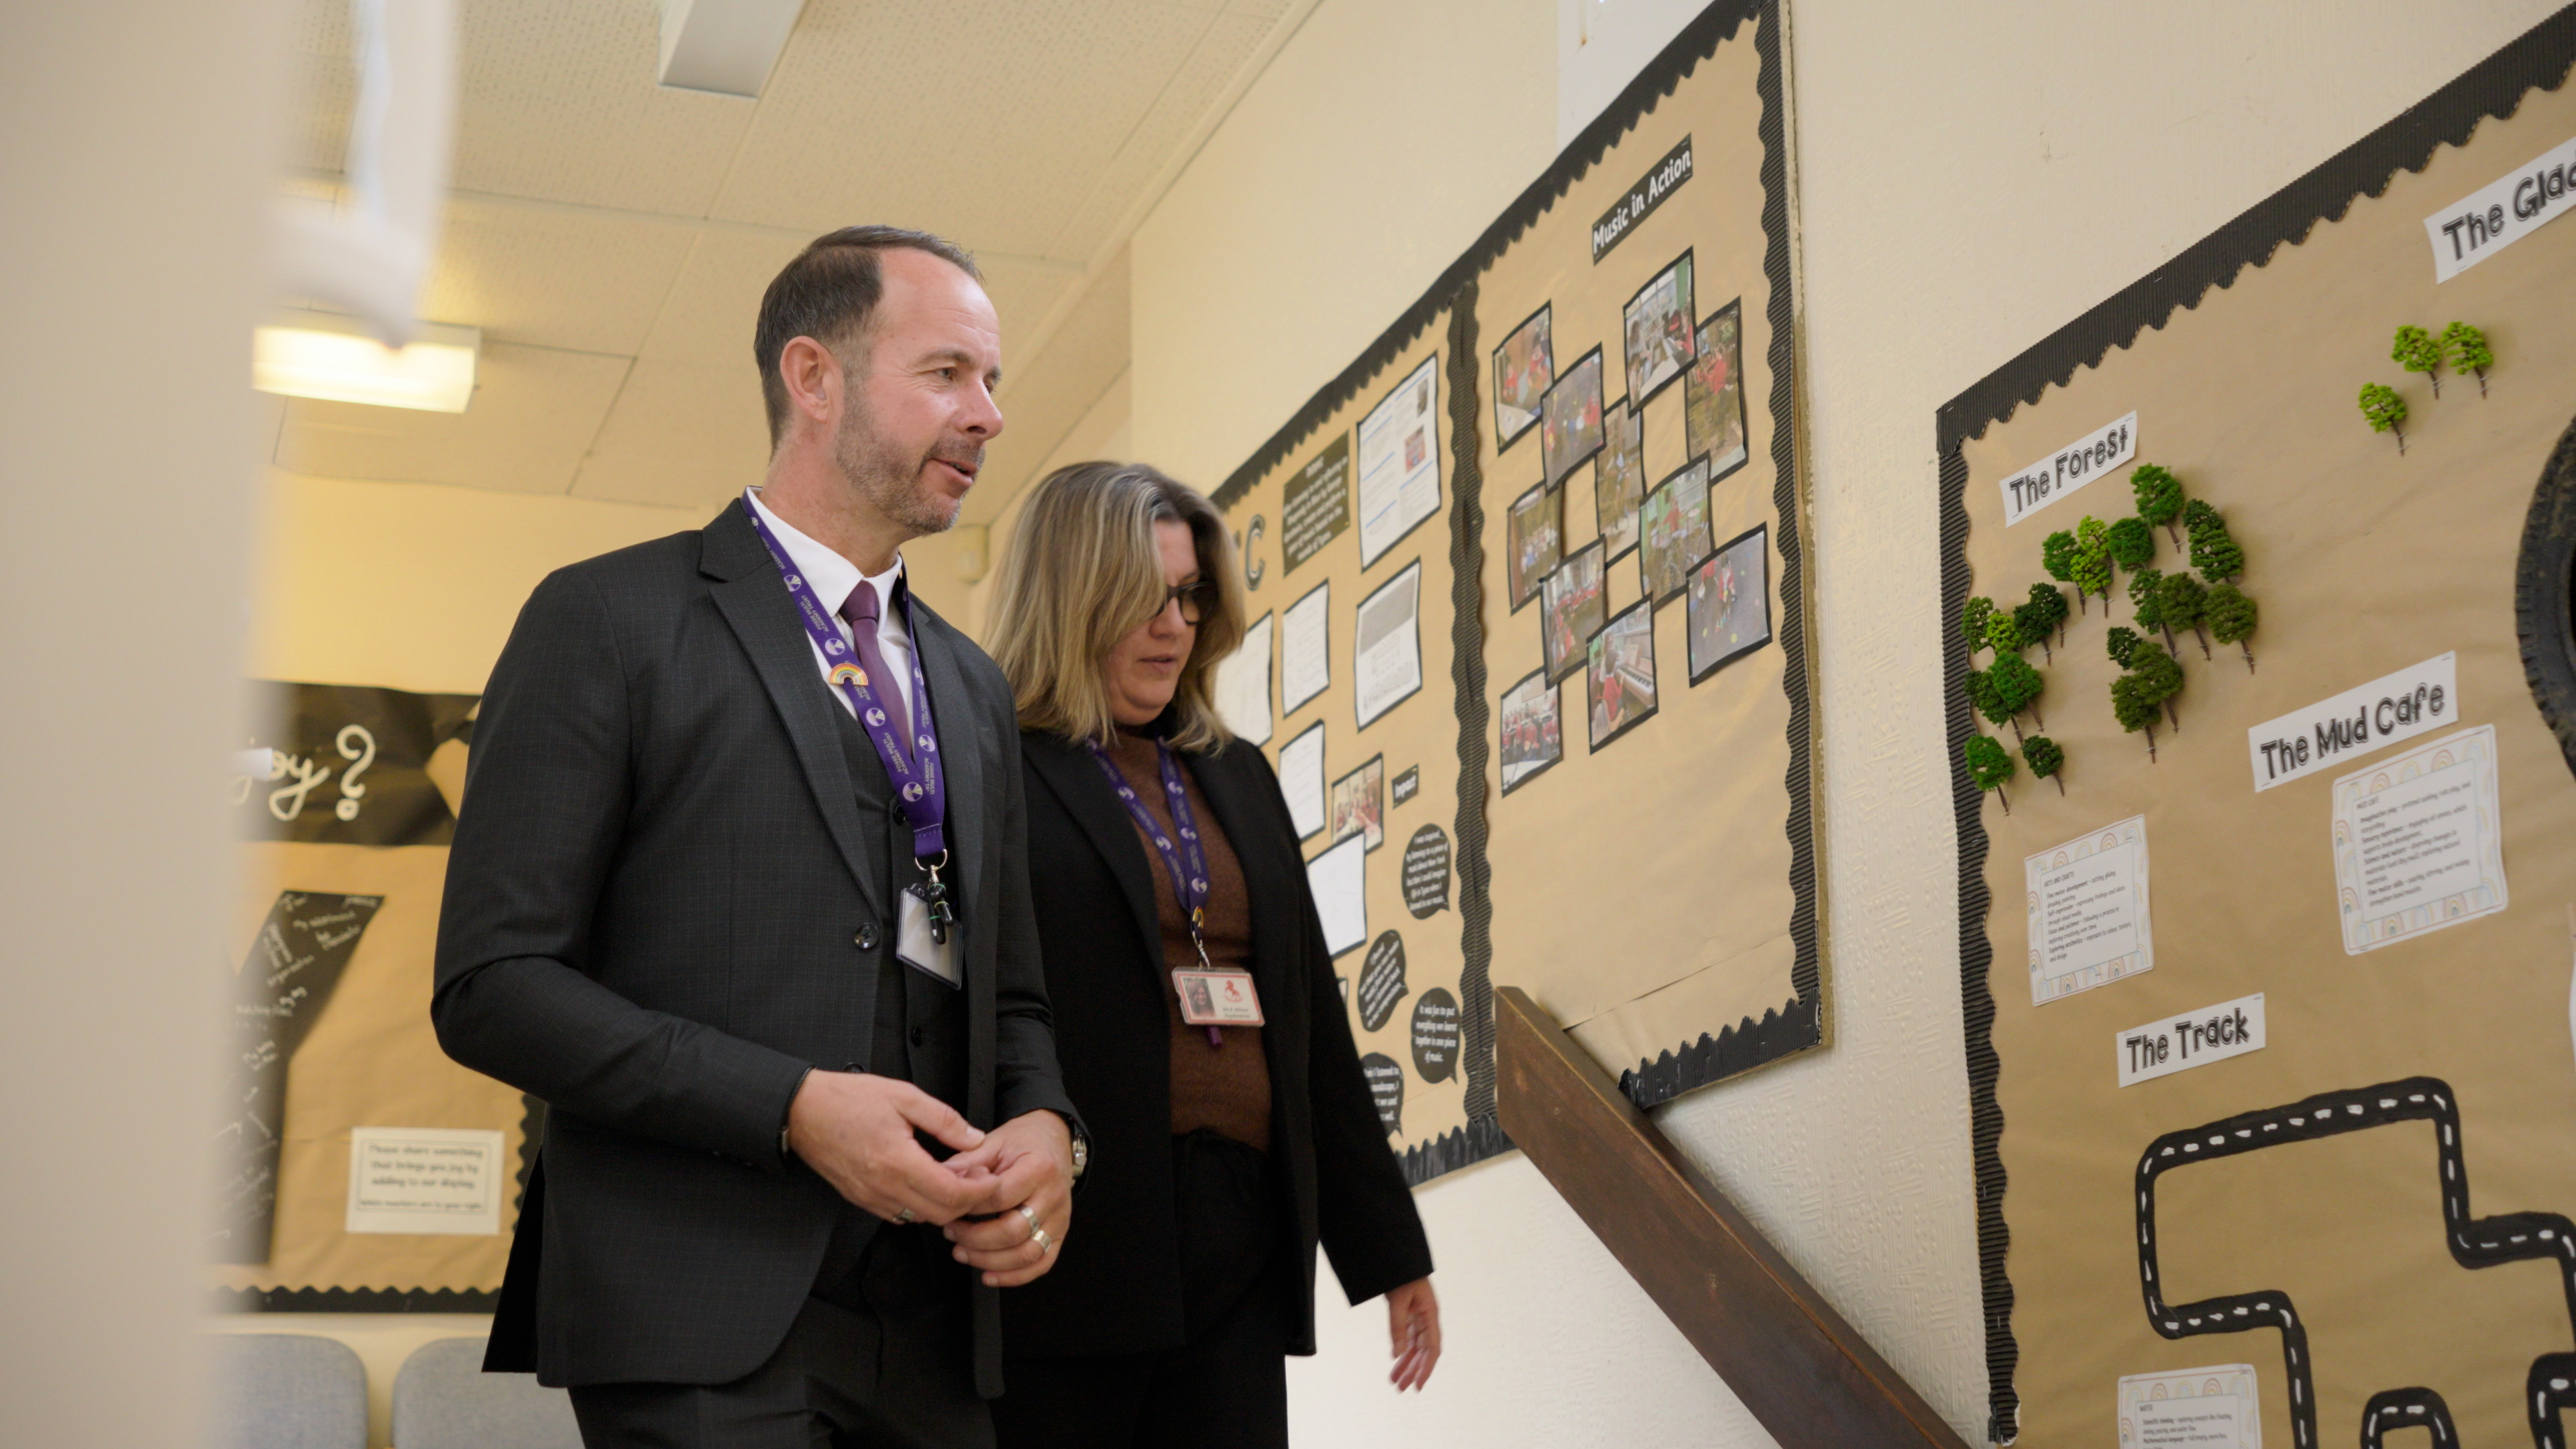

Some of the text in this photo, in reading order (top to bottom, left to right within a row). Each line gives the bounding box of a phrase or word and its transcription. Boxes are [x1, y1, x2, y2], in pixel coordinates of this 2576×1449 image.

[1593, 150, 1691, 255] Music in Action
[2441, 204, 2506, 261] The
[2009, 424, 2128, 513] The Forest
[802, 595, 830, 633] ACADEMY TRUST
[810, 614, 823, 631] FOSSE
[2260, 682, 2445, 780] The Mud Cafe
[884, 732, 910, 775] ACADEMY TRUST
[892, 753, 903, 773] FOSSE
[2062, 871, 2074, 881] CRAFTS
[2066, 881, 2088, 892] development
[2048, 905, 2073, 917] Self-expression
[2077, 897, 2094, 906] expressing
[2048, 918, 2061, 926] through
[2065, 921, 2080, 929] patience
[2102, 908, 2115, 917] process
[2049, 945, 2065, 953] Exploring
[2127, 1007, 2250, 1073] The Track
